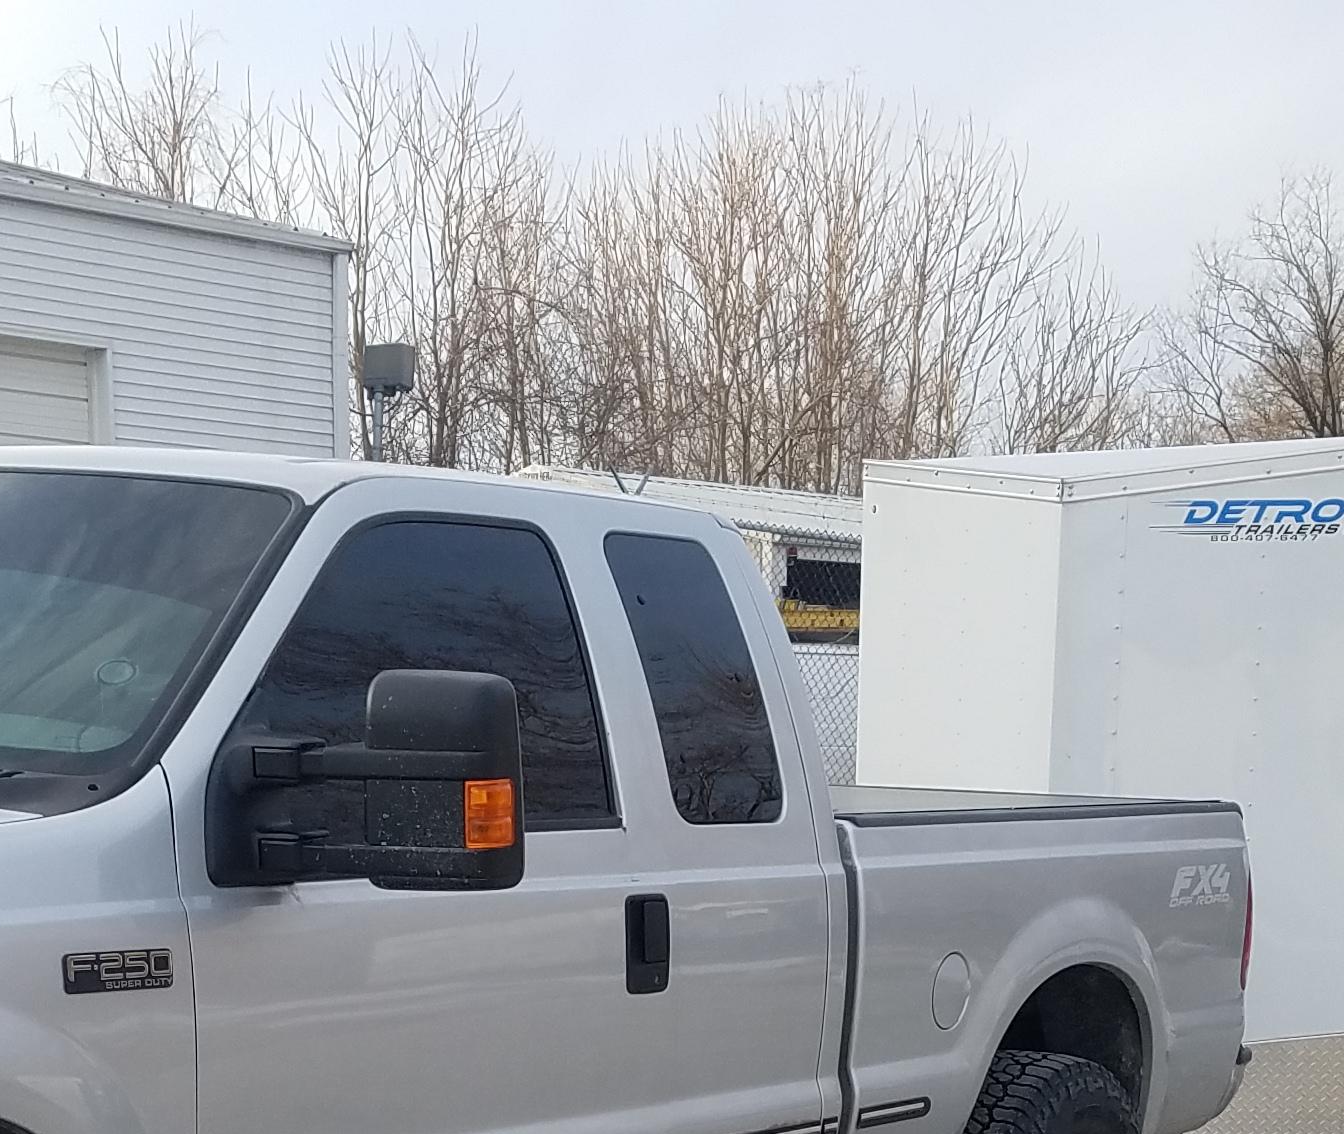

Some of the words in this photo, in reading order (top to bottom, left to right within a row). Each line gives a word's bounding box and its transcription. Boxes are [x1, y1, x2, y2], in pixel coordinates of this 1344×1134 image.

[1233, 524, 1340, 535] TRAILERS
[1170, 863, 1231, 898] FX4
[1169, 896, 1193, 908] OFF
[1196, 894, 1230, 905] ROAD
[105, 980, 142, 989] SUPER
[145, 977, 173, 987] DUTY
